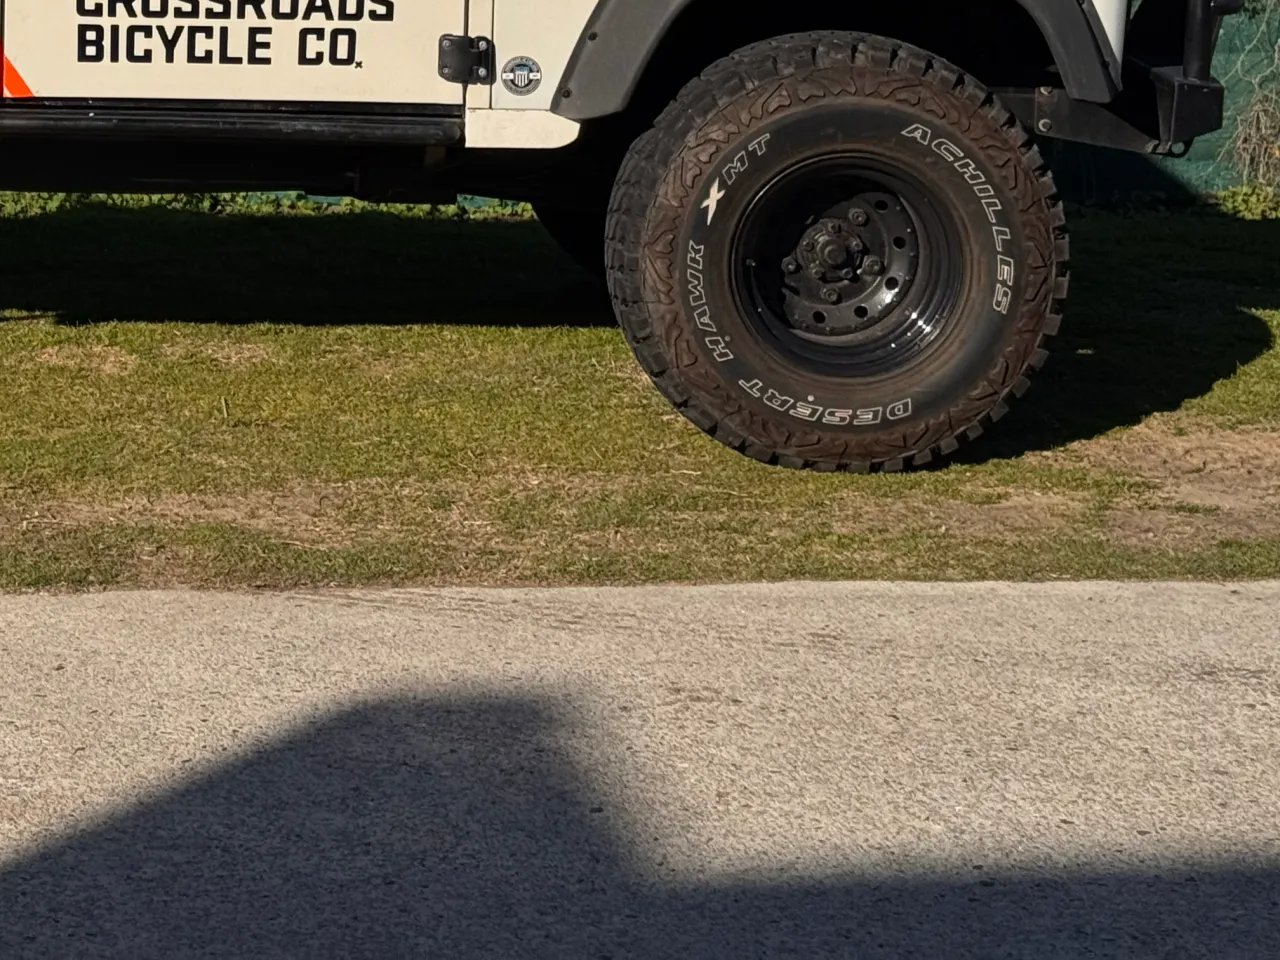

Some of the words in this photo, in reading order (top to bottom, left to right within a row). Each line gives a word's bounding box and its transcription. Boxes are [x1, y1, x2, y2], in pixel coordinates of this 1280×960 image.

[77, 24, 272, 64] BICYCLE
[298, 27, 363, 68] CO.
[901, 123, 1015, 316] ACHILLES
[688, 240, 735, 363] HAWK
[738, 377, 913, 427] DESERT
